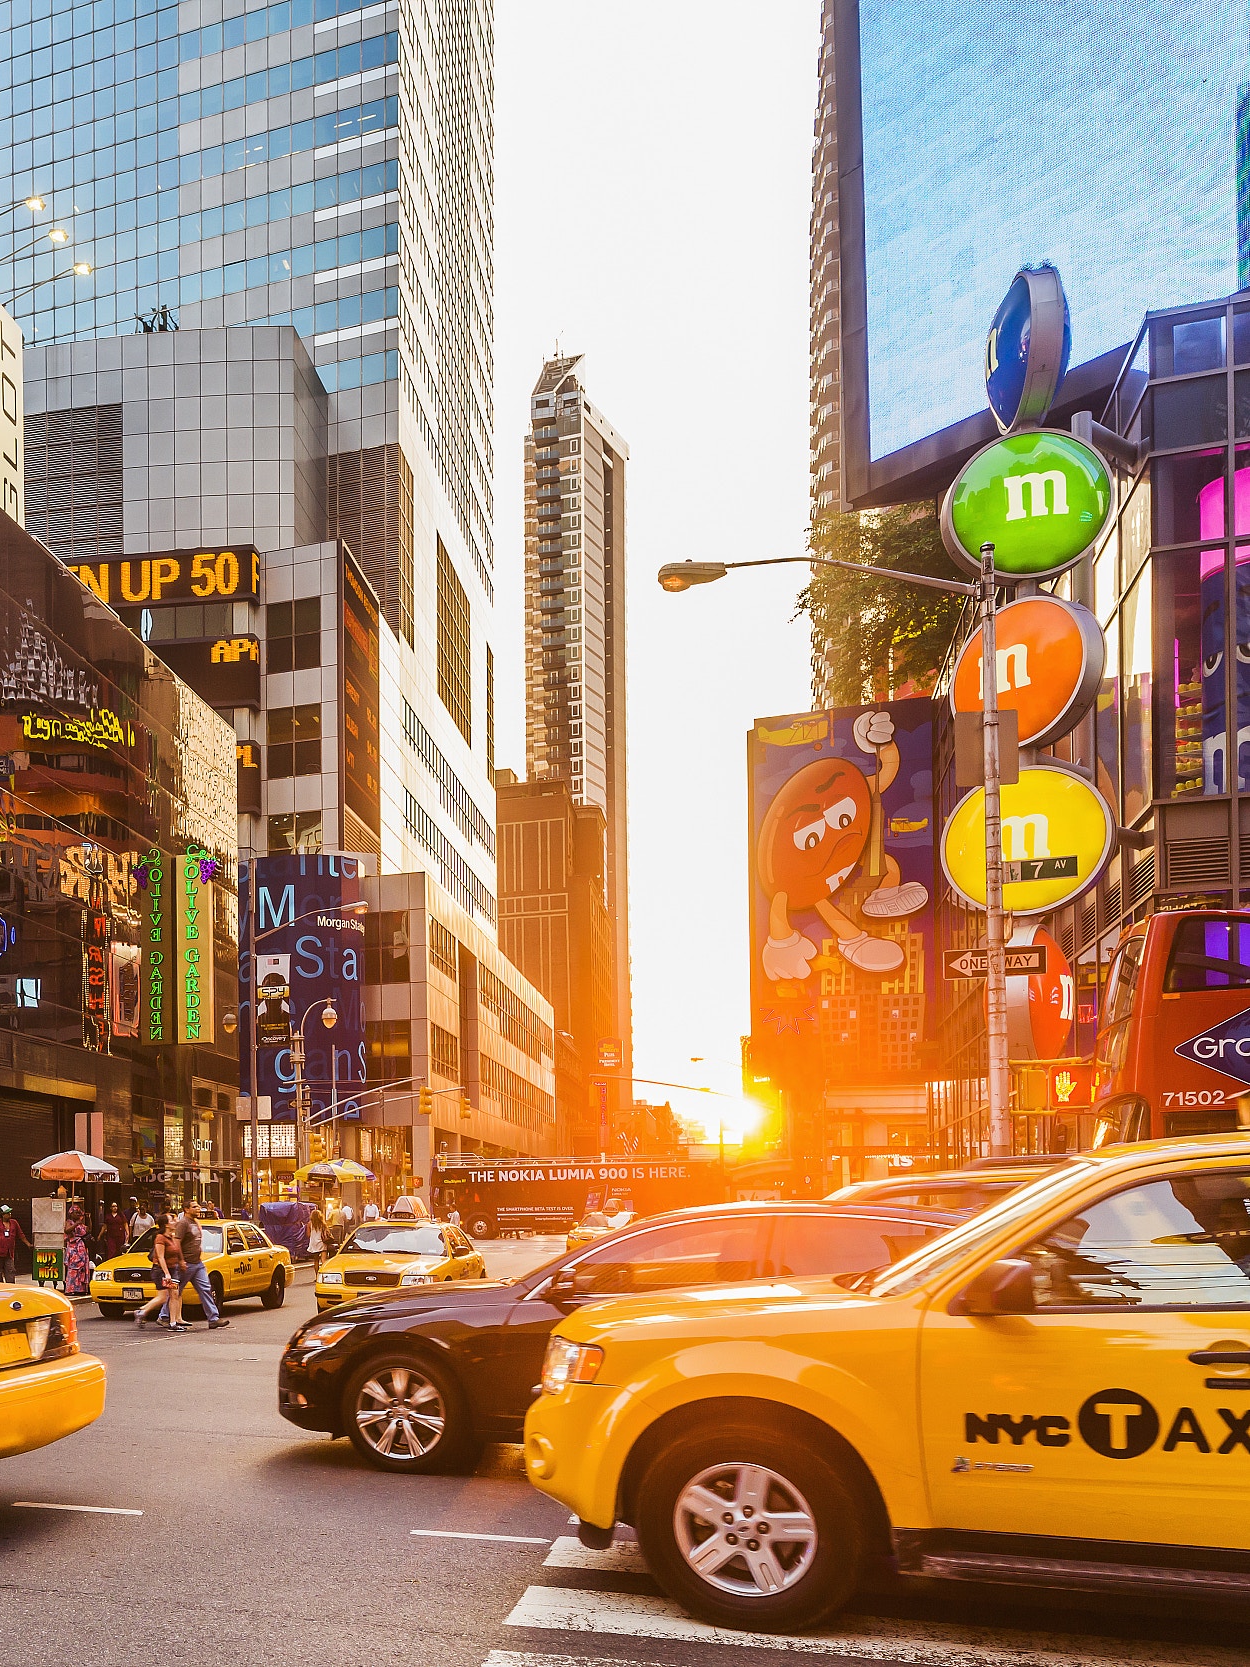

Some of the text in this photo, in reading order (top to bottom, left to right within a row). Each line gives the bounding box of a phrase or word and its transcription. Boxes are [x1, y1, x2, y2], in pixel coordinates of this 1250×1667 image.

[1003, 468, 1069, 522] m
[120, 558, 181, 602] UP
[191, 551, 239, 597] 50
[1030, 860, 1067, 878] 7 AV
[317, 915, 350, 931] Morgan
[184, 864, 201, 1040] OLIVE GARDEN
[960, 955, 1033, 970] ONE WAY
[261, 987, 285, 997] SPY
[1162, 1090, 1226, 1107] 71502
[469, 1166, 691, 1183] THE NOKIA LUMIA 900 IS HERE.
[36, 1252, 56, 1264] NUTS
[38, 1267, 59, 1279] NUTS
[964, 1411, 1072, 1448] NYC
